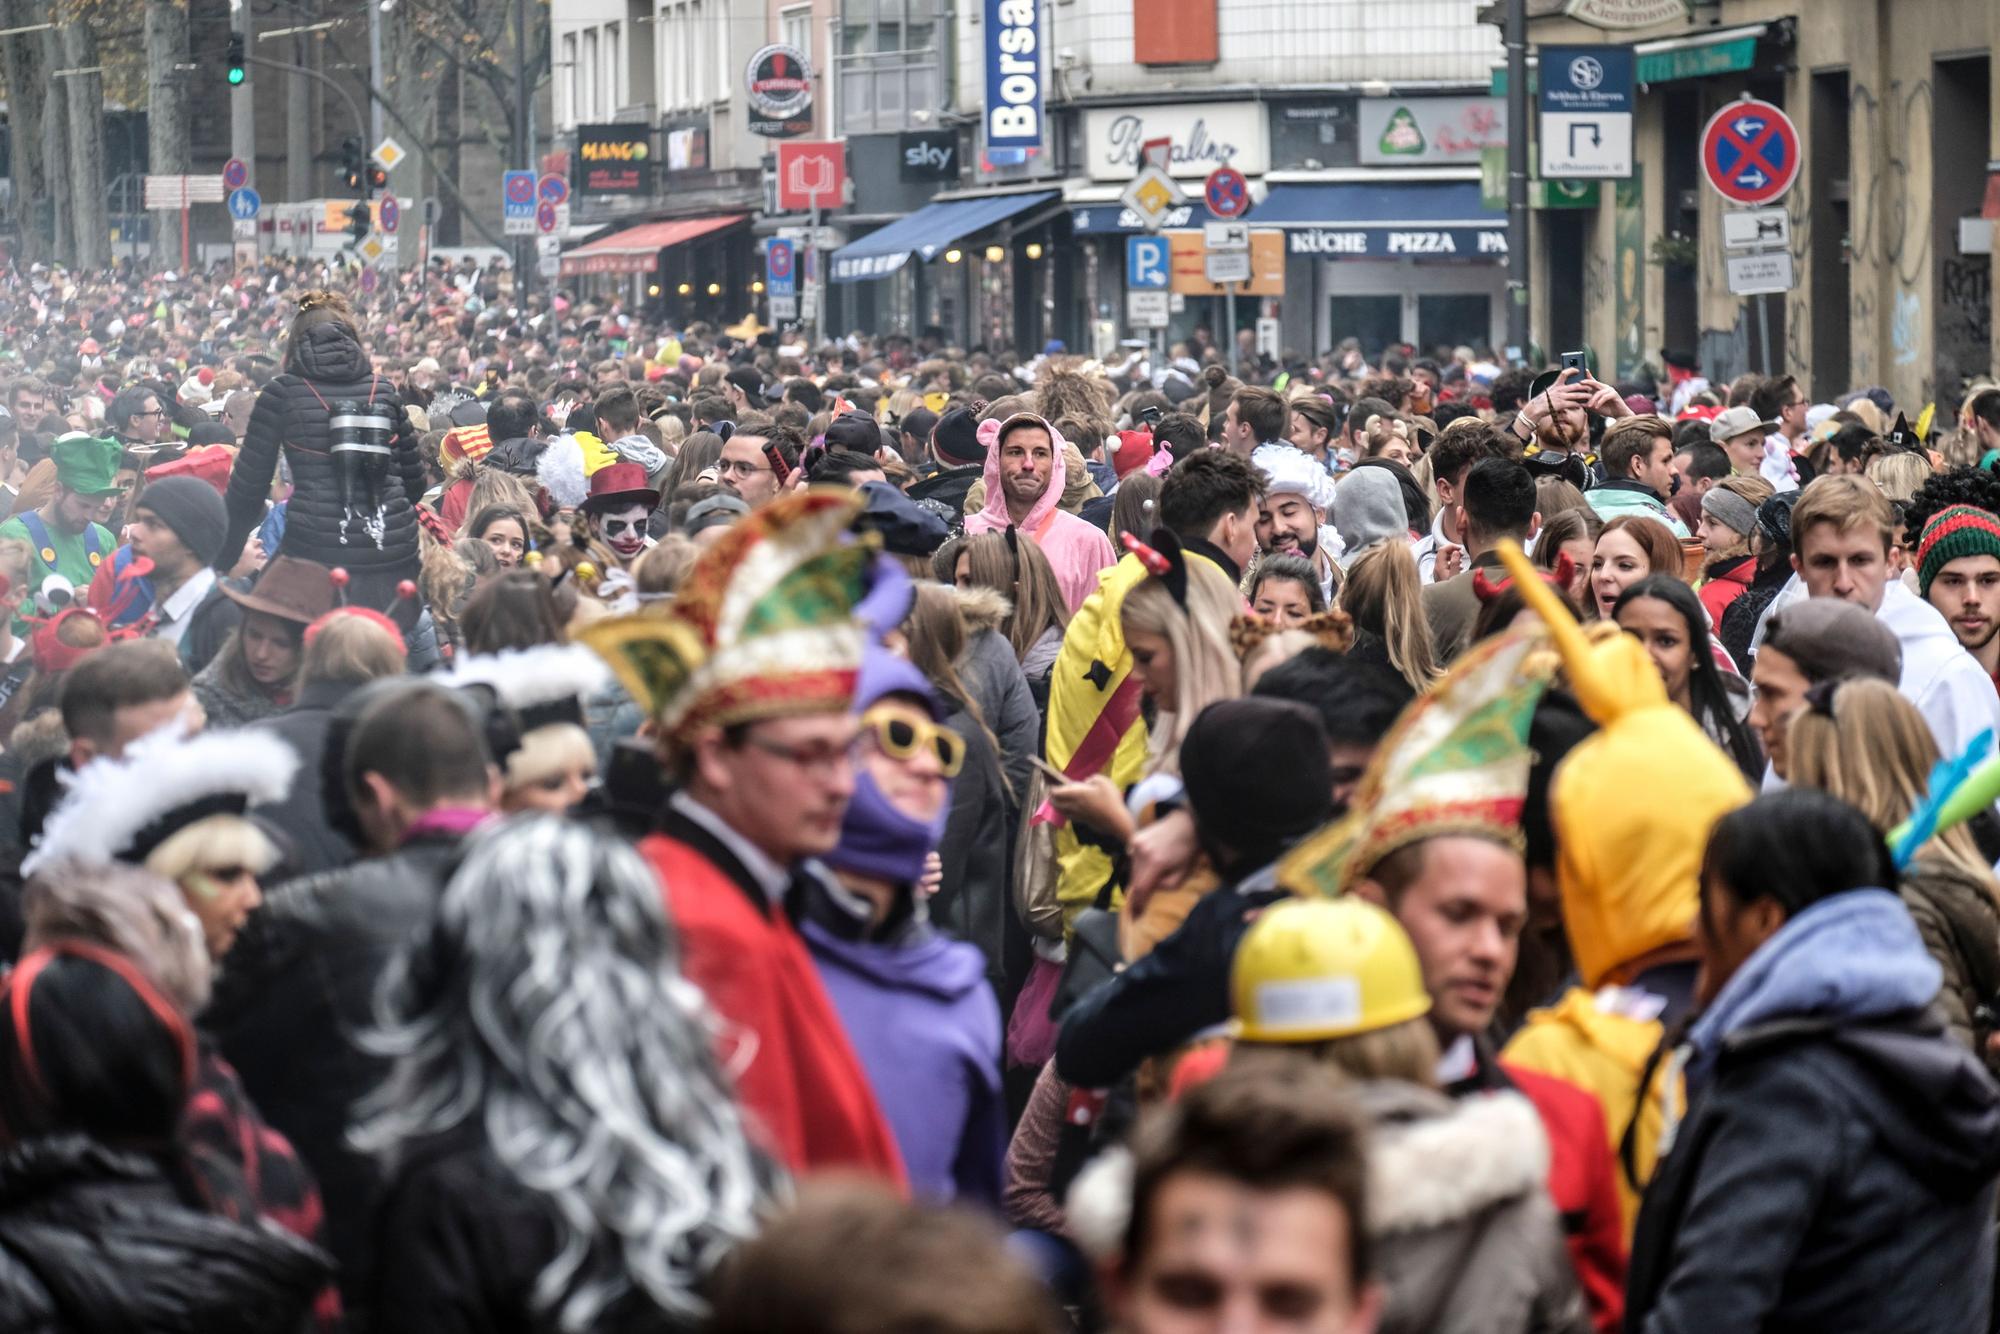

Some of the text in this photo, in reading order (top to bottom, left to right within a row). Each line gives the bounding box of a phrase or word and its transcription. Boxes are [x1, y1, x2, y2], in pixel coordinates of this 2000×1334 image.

[581, 142, 649, 161] MANGO
[905, 141, 953, 171] sky
[1290, 229, 1367, 253] KÜCHE
[1387, 232, 1456, 253] PIZZA
[1135, 243, 1160, 282] P
